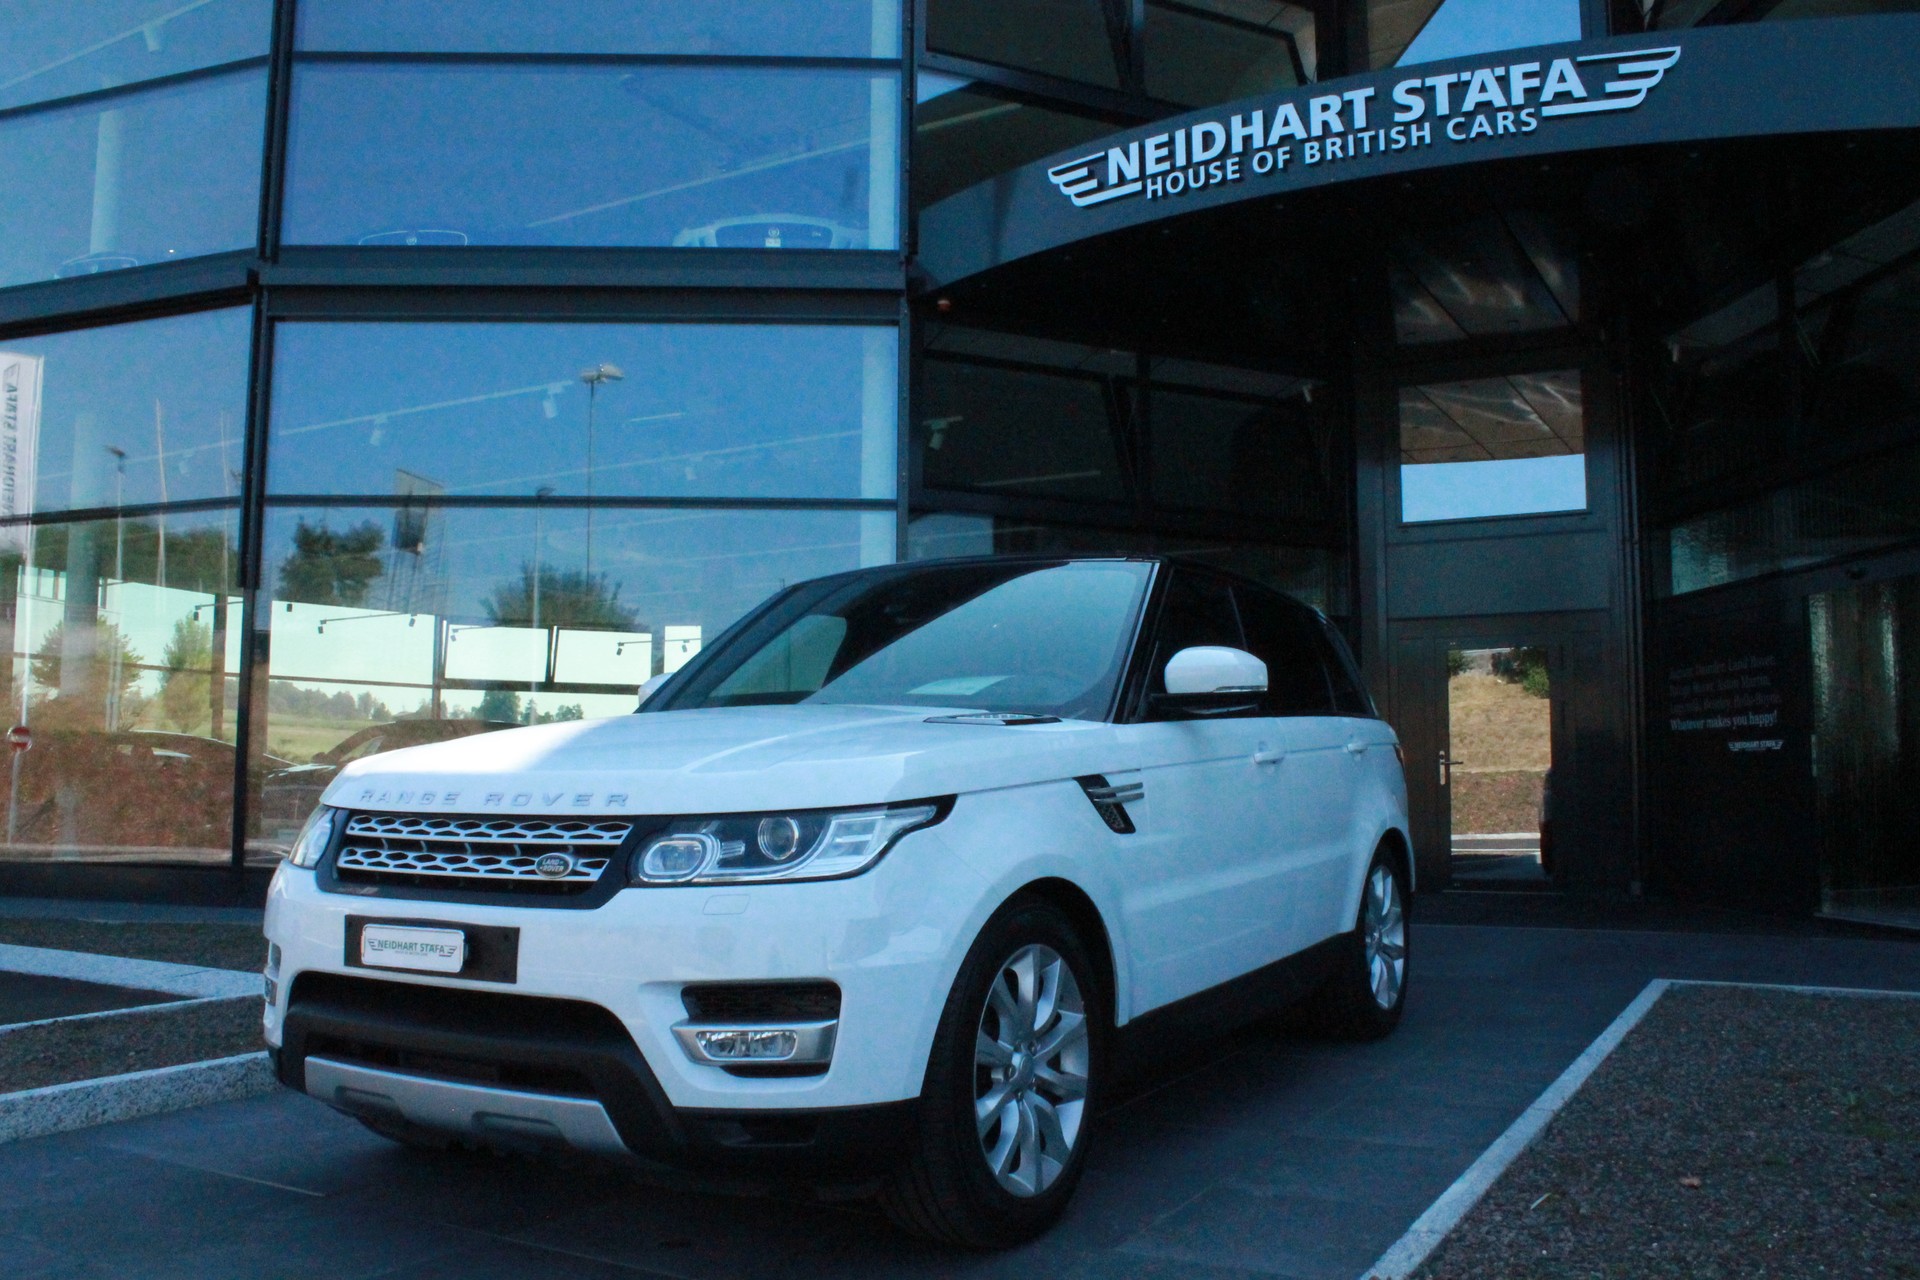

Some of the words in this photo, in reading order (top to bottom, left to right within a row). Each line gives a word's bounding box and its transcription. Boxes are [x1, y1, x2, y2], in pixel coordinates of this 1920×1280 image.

[1107, 86, 1375, 186] NEIDHART
[1392, 57, 1588, 124] STÄFA
[1146, 156, 1241, 200] HOUSE
[1252, 145, 1291, 174] OF
[1304, 121, 1432, 165] BRITISH
[1446, 107, 1538, 141] CARS
[1732, 715, 1747, 730] you
[358, 788, 462, 806] RANGE
[483, 792, 630, 807] ROVER
[377, 939, 418, 952] NEIDHART
